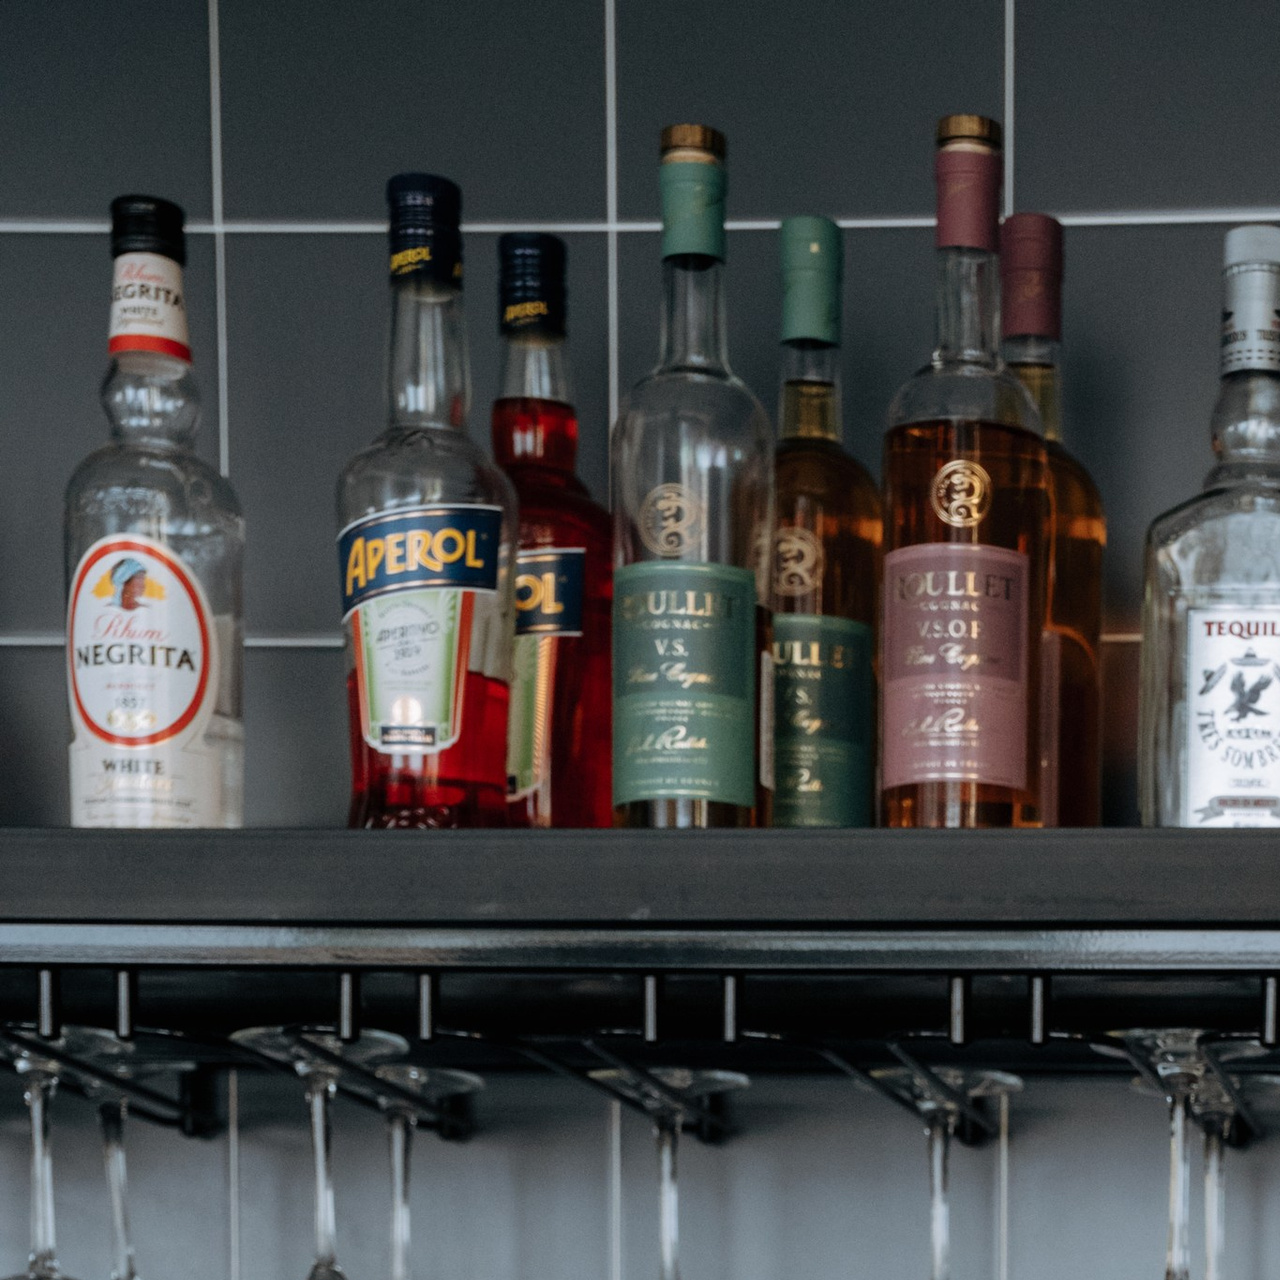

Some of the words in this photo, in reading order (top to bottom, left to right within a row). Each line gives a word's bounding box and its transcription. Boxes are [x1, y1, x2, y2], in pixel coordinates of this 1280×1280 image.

[346, 528, 485, 597] APEROL
[92, 613, 167, 642] Rhum
[76, 644, 196, 672] NEGRITA
[1197, 709, 1225, 752] TRES
[102, 759, 165, 775] WHITE
